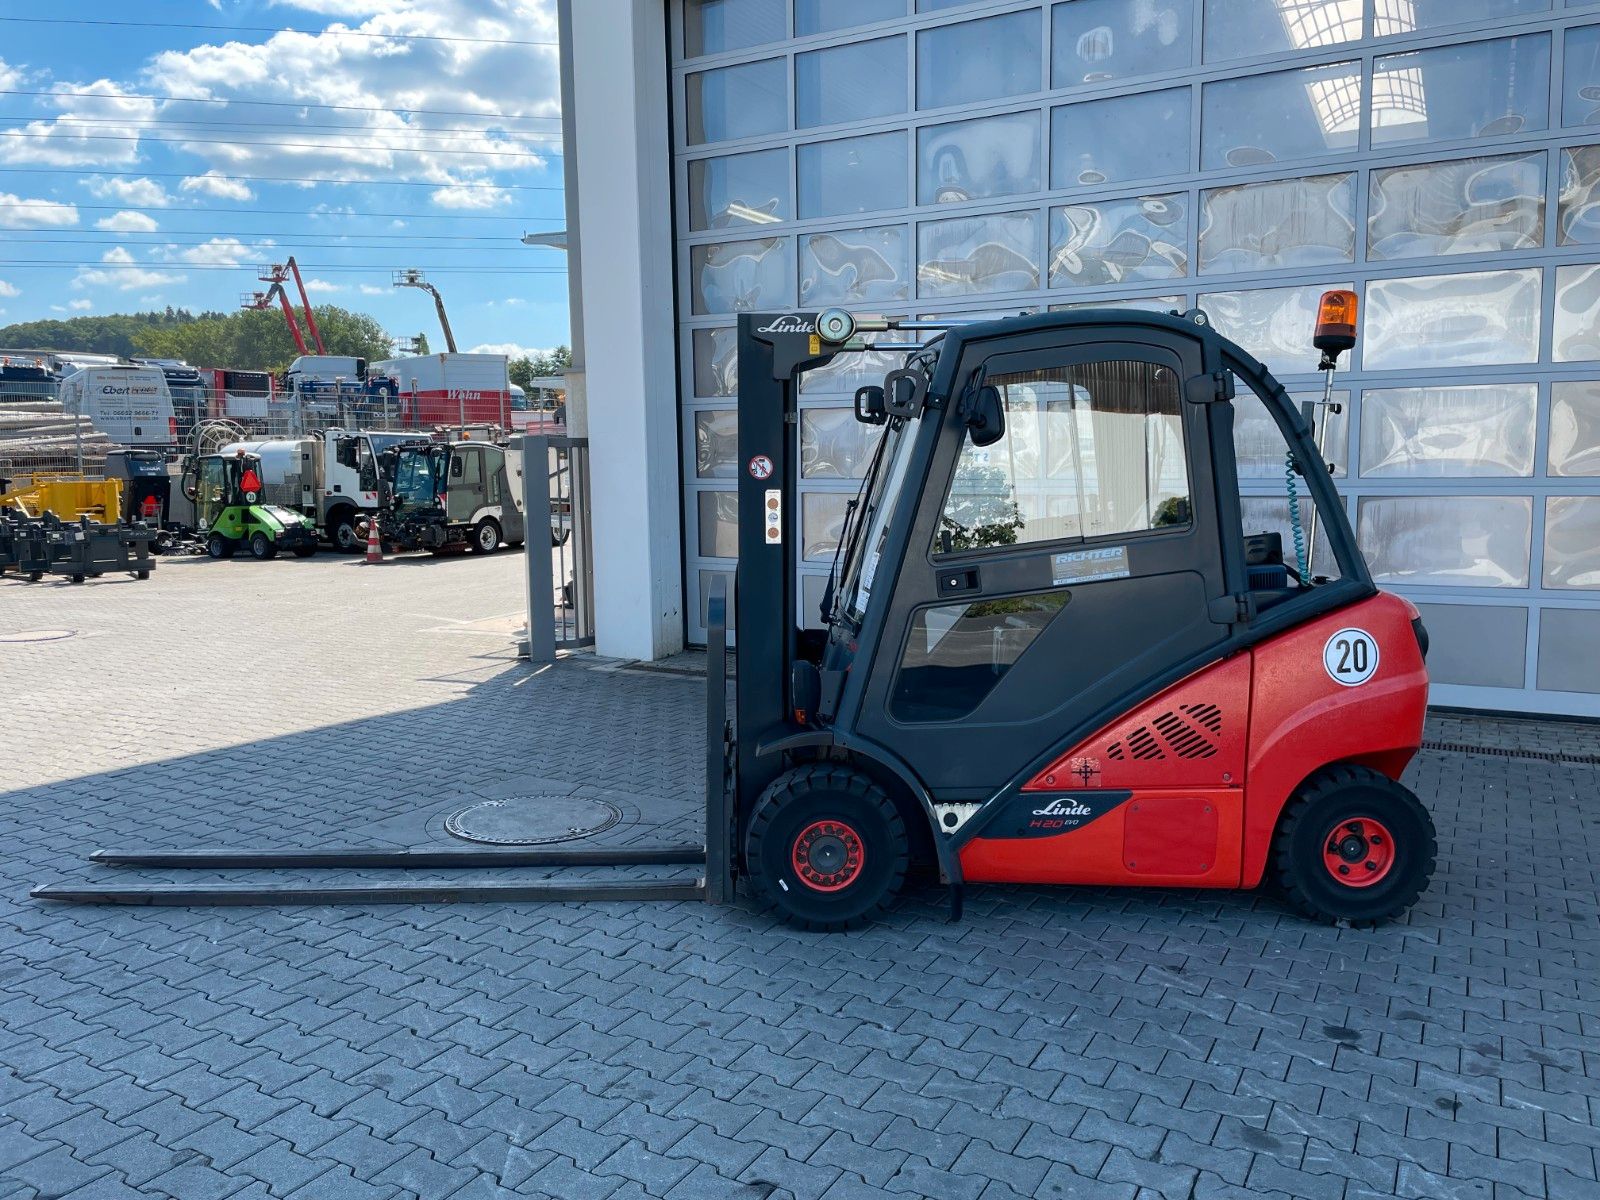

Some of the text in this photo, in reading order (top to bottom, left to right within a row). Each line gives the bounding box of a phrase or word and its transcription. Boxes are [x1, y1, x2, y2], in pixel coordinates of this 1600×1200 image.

[757, 315, 815, 333] Linde
[103, 385, 130, 395] Ebert
[1335, 638, 1368, 673] 20
[1032, 798, 1091, 816] Linde
